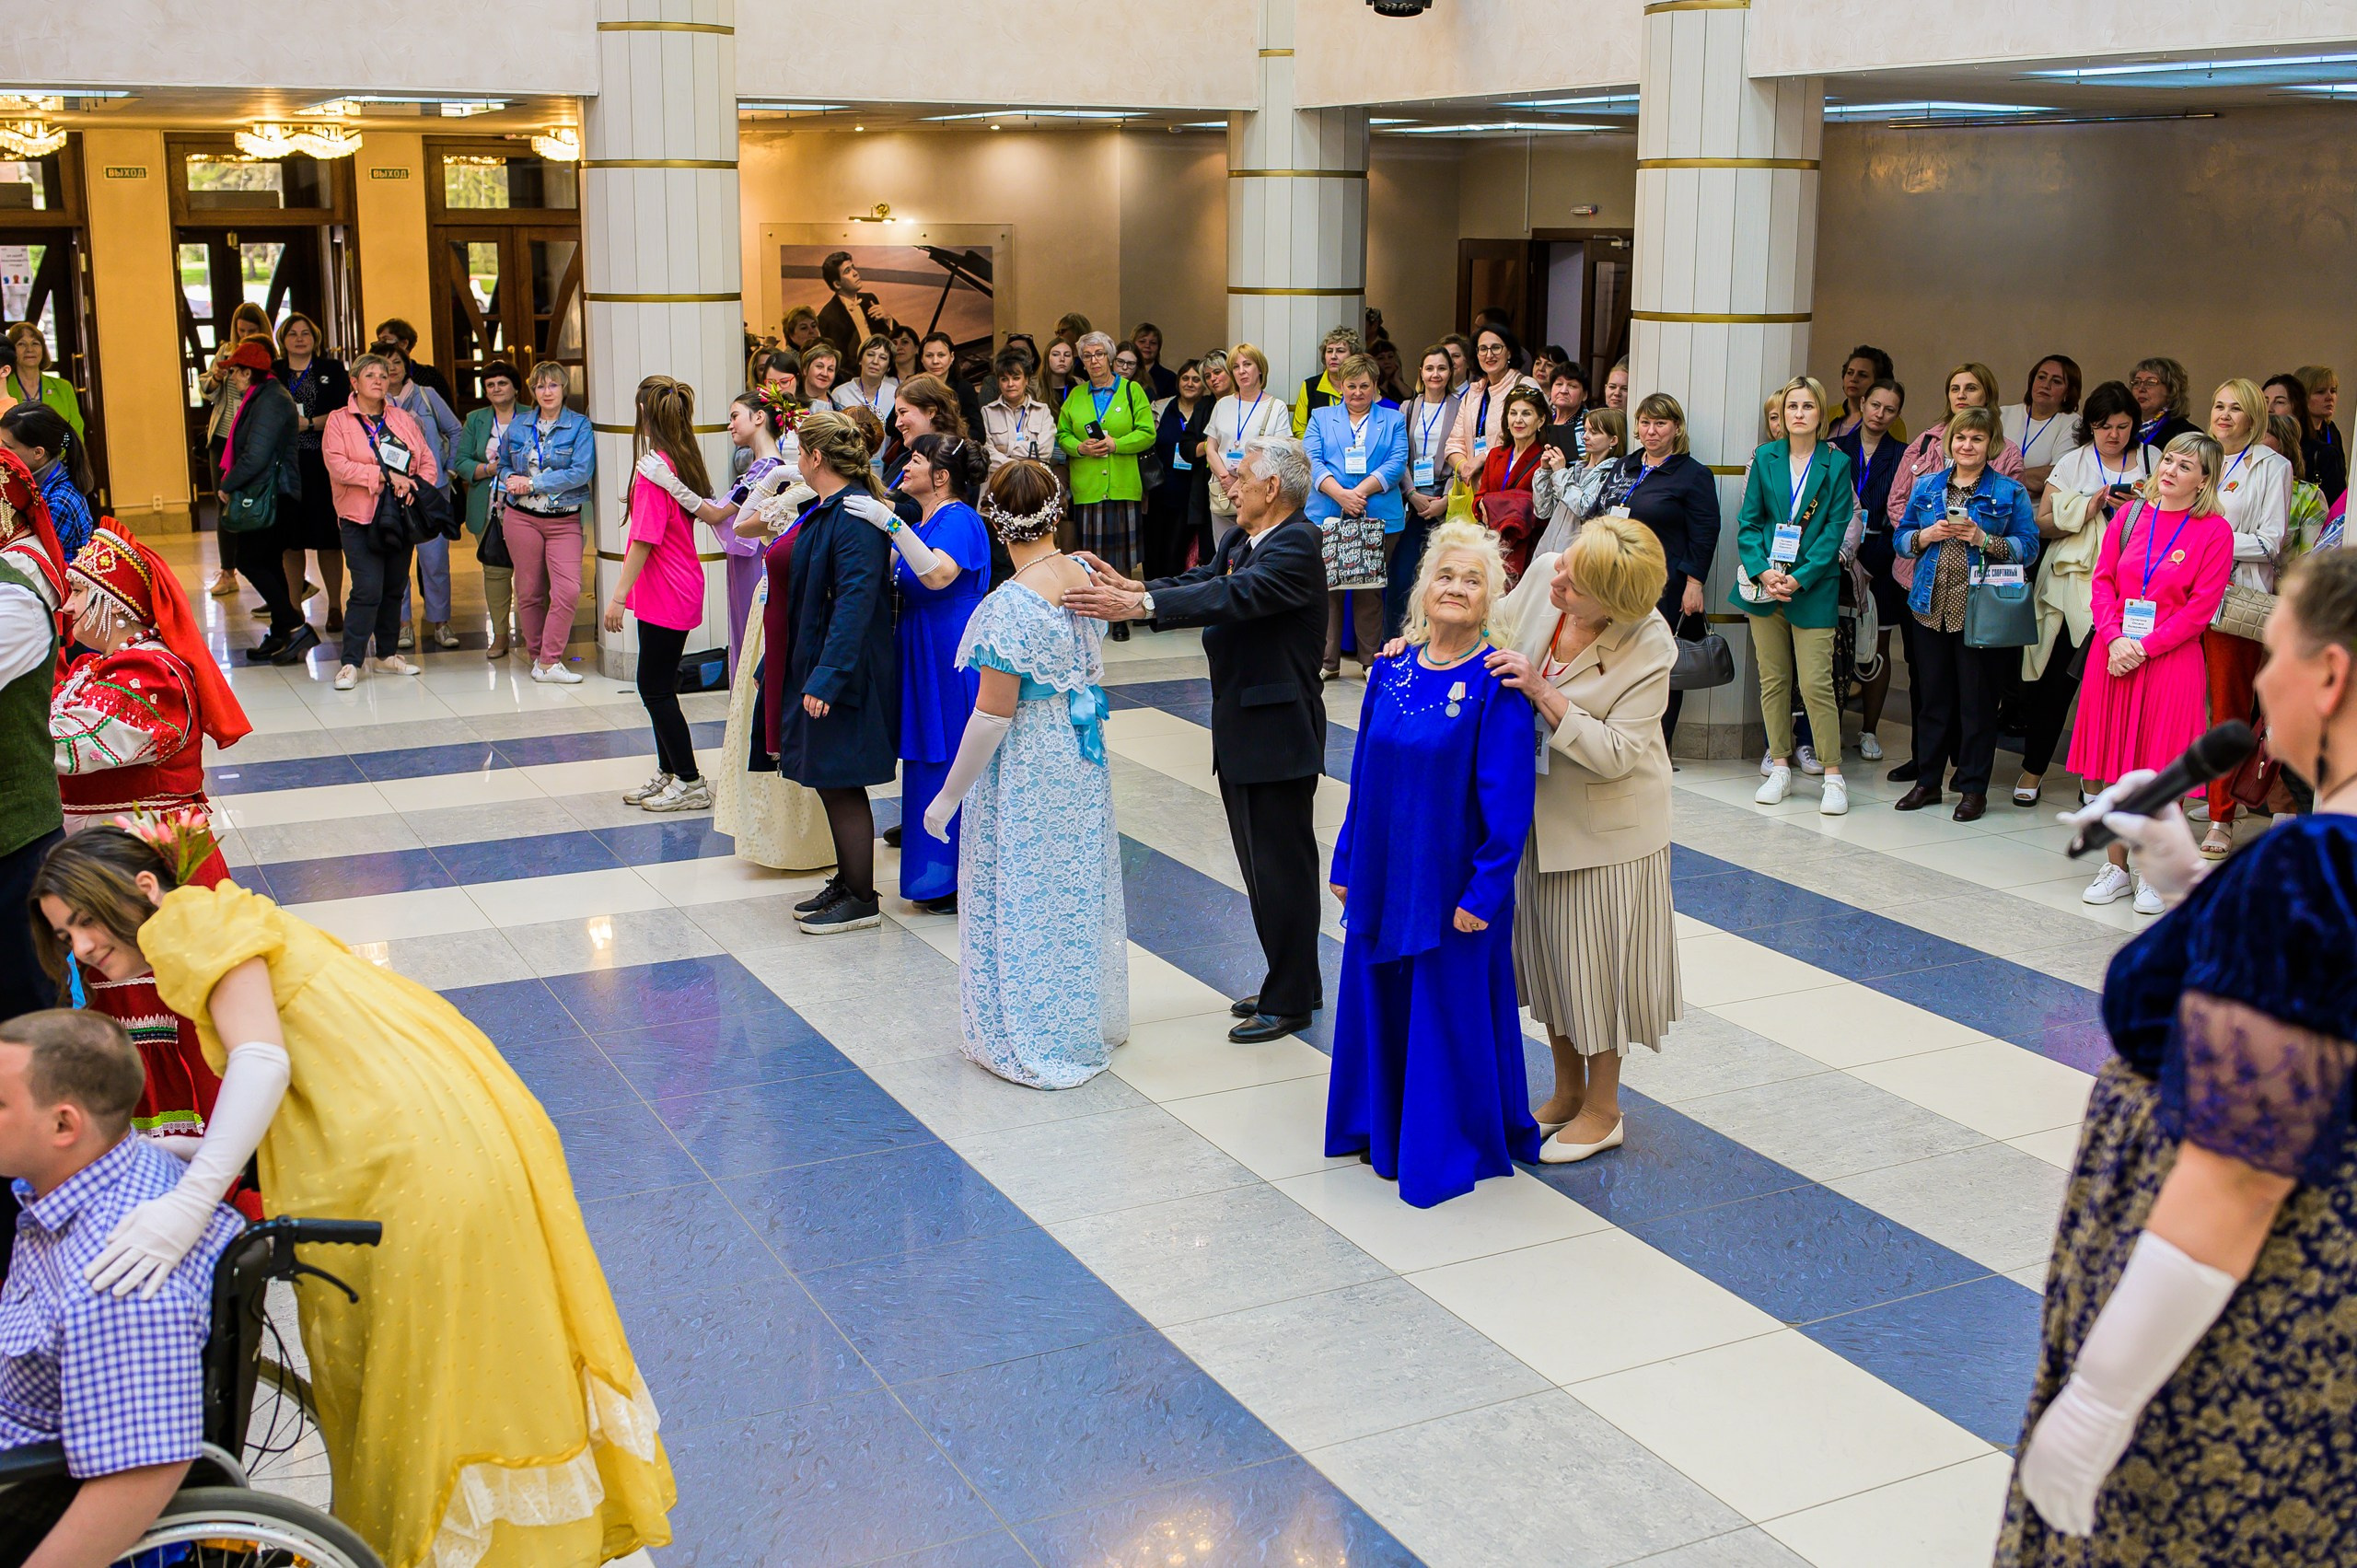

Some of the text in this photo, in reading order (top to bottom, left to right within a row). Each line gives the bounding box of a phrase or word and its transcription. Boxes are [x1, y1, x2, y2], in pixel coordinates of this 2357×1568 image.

[108, 168, 145, 178] ВЫХОД
[373, 169, 407, 179] ВЫХОД
[1991, 567, 2017, 577] СПОРТИВНЫЙ
